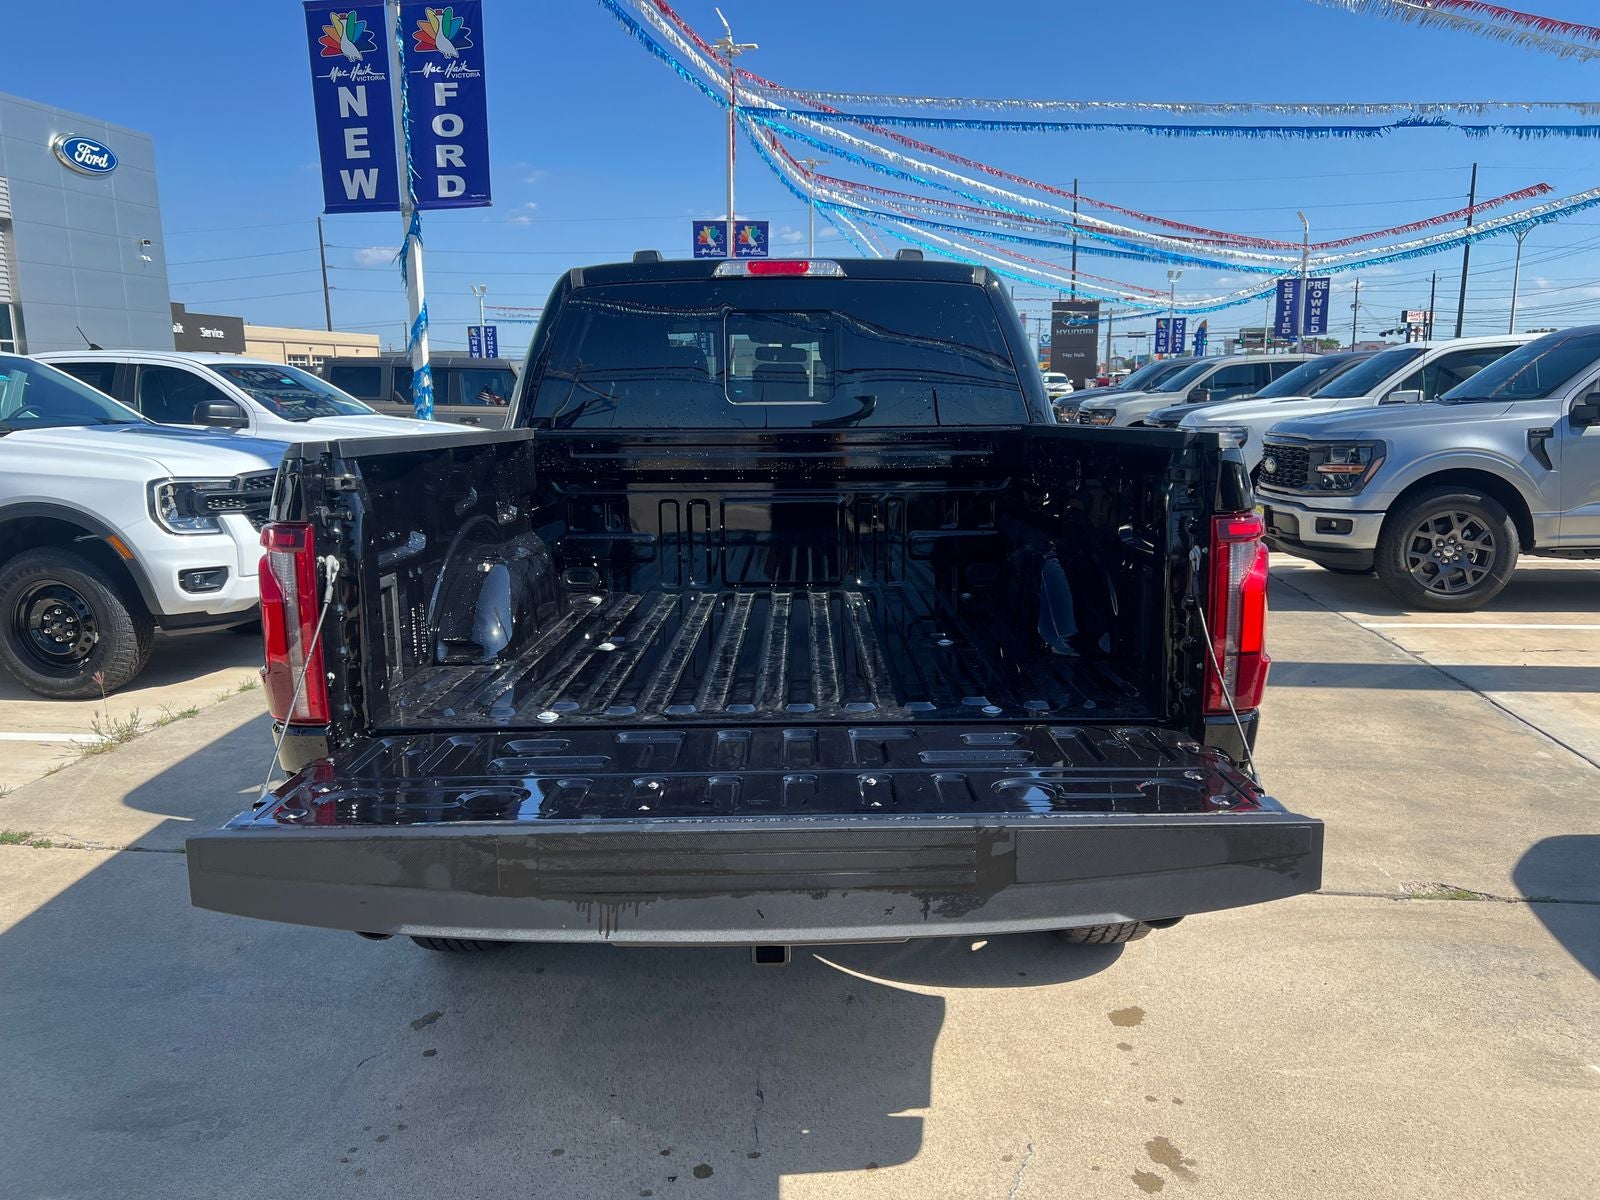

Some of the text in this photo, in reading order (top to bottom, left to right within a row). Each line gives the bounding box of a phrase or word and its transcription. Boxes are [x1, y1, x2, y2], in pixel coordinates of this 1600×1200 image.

[329, 63, 373, 83] Mac Haik
[421, 60, 469, 78] Mac Haik
[451, 71, 480, 79] VICTORIA
[337, 85, 379, 200] NEW
[432, 82, 467, 198] FORD
[74, 142, 108, 168] Ford
[1307, 281, 1329, 290] PRE
[1281, 281, 1294, 334] CERTIFIED
[1310, 290, 1323, 333] OWNED
[172, 322, 224, 339] aik Service
[1056, 328, 1095, 336] HYUNDAI
[1175, 320, 1183, 352] HYUNDAI
[472, 340, 480, 358] NEW
[1157, 332, 1166, 352] NEW
